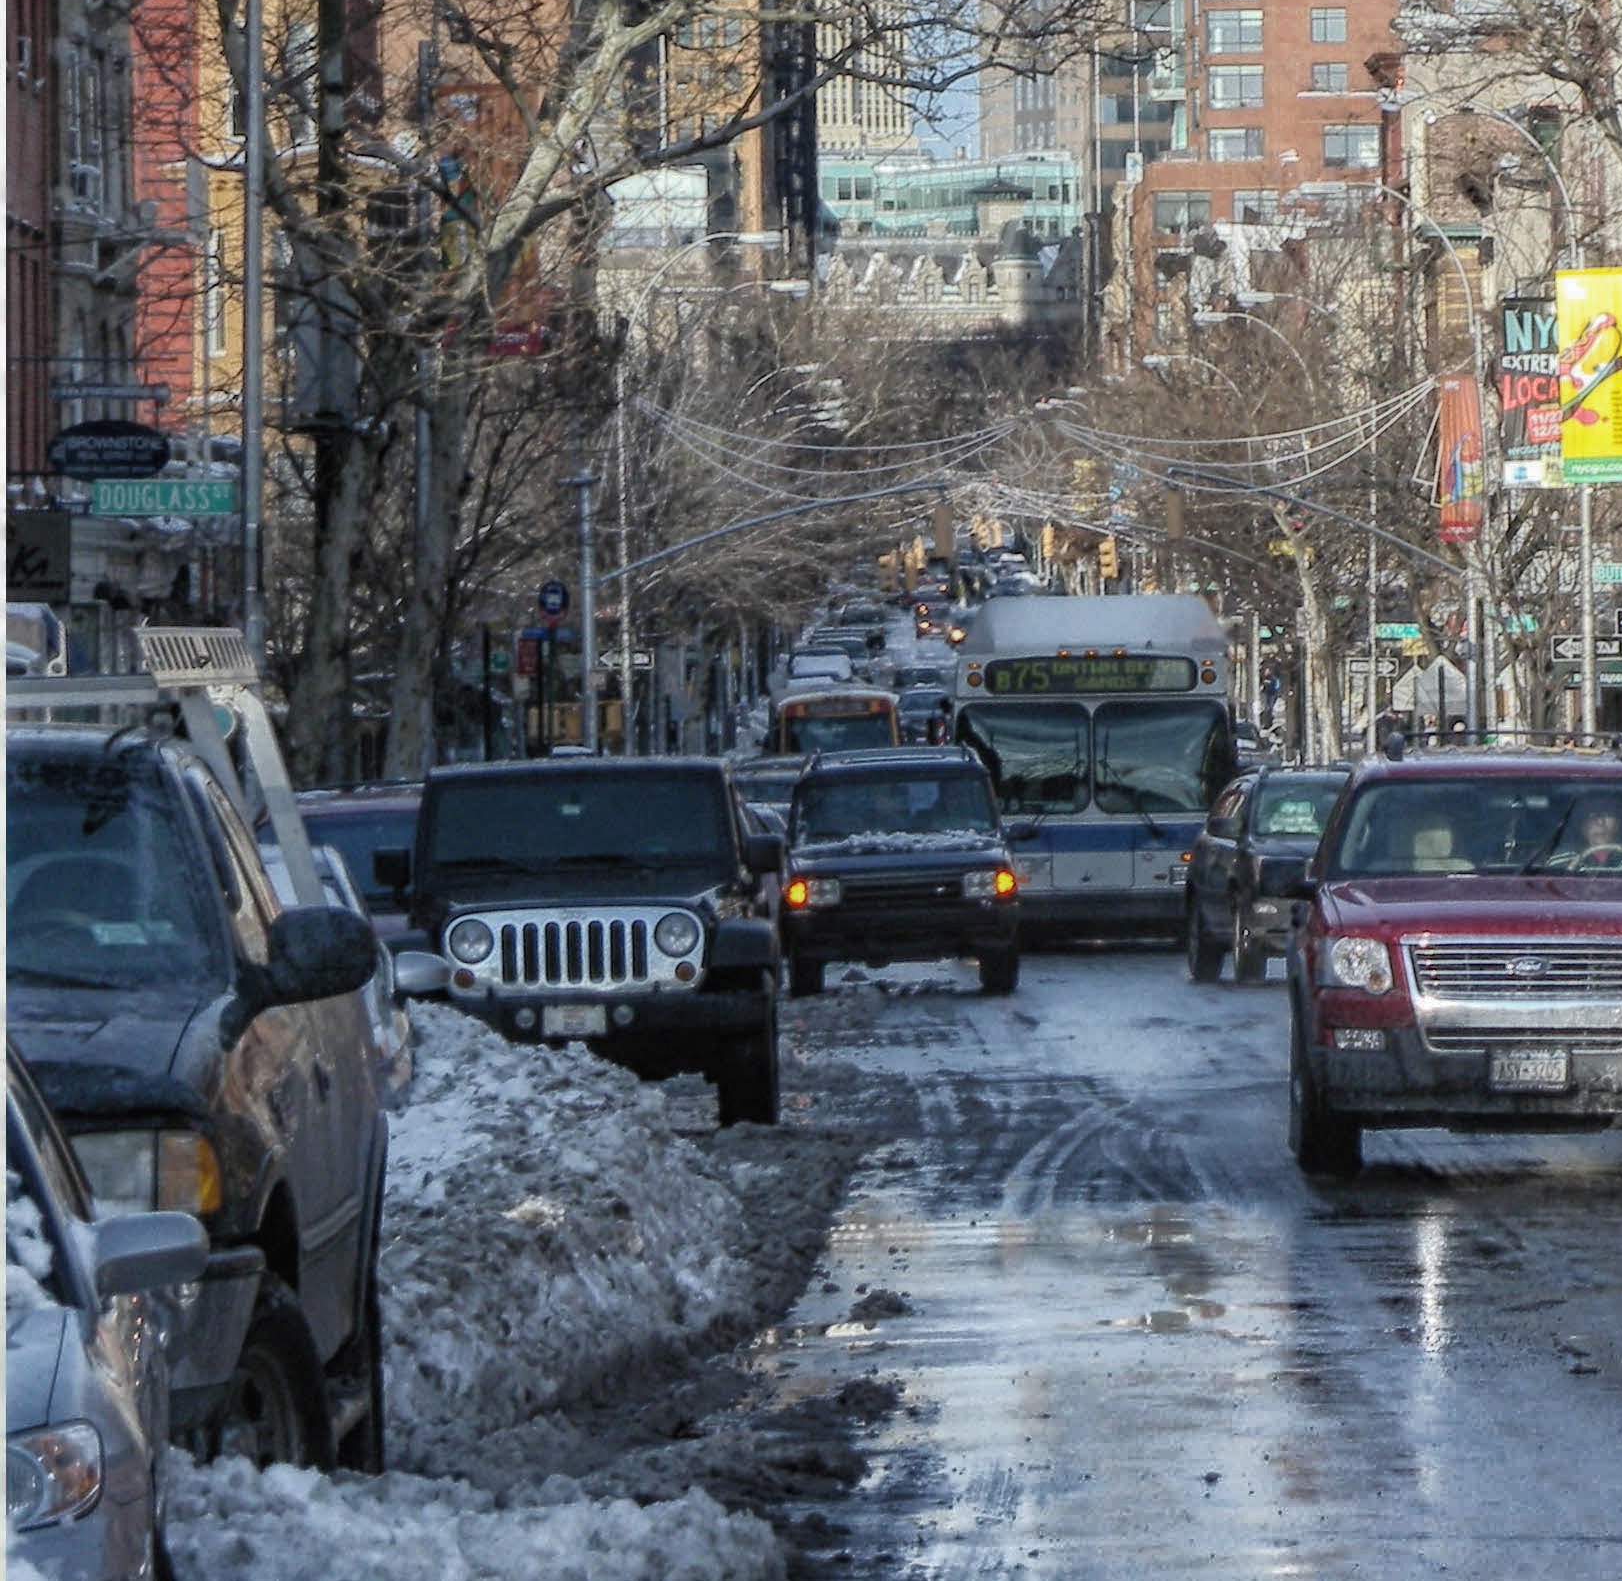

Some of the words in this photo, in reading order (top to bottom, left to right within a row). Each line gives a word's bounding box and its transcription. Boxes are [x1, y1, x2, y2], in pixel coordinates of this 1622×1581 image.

[1505, 309, 1557, 353] NY
[1502, 353, 1558, 375] EXTREM
[1502, 373, 1558, 411] LOCA
[100, 484, 209, 509] DOUGLASS
